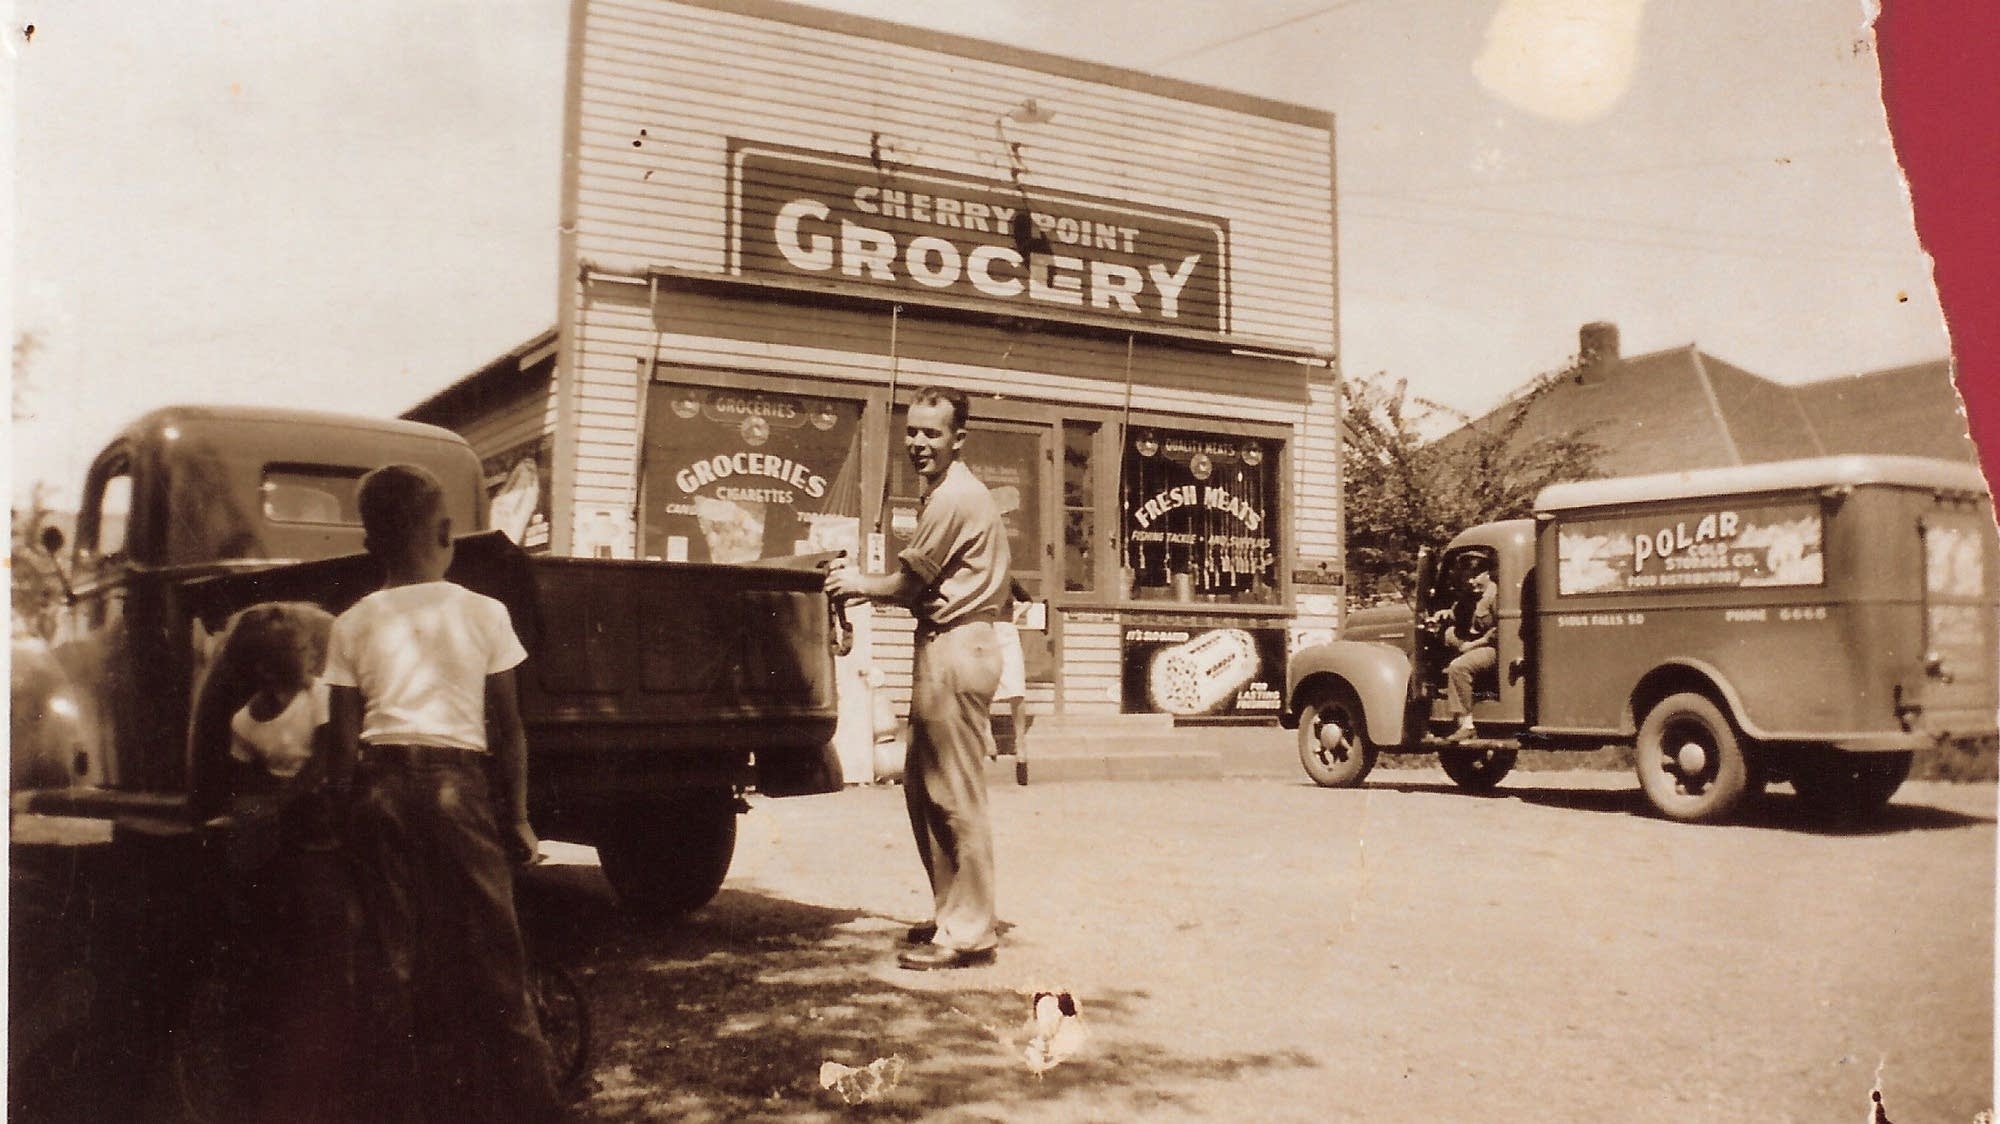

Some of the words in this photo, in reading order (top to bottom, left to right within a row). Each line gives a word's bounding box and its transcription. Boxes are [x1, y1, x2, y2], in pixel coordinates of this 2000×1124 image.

[852, 185, 1017, 233] CHERRY
[1031, 212, 1139, 254] POINT
[774, 199, 1200, 318] GROCERY
[716, 396, 797, 419] GROCERIES
[675, 452, 828, 498] GROCERIES
[716, 486, 793, 503] CIGARETTES
[1134, 485, 1197, 529] FRESH
[1203, 486, 1262, 531] MEATS
[1166, 532, 1197, 544] TACKLE
[1634, 511, 1740, 573] POLAR
[1592, 614, 1623, 625] FALLS
[1725, 609, 1767, 622] PHONE
